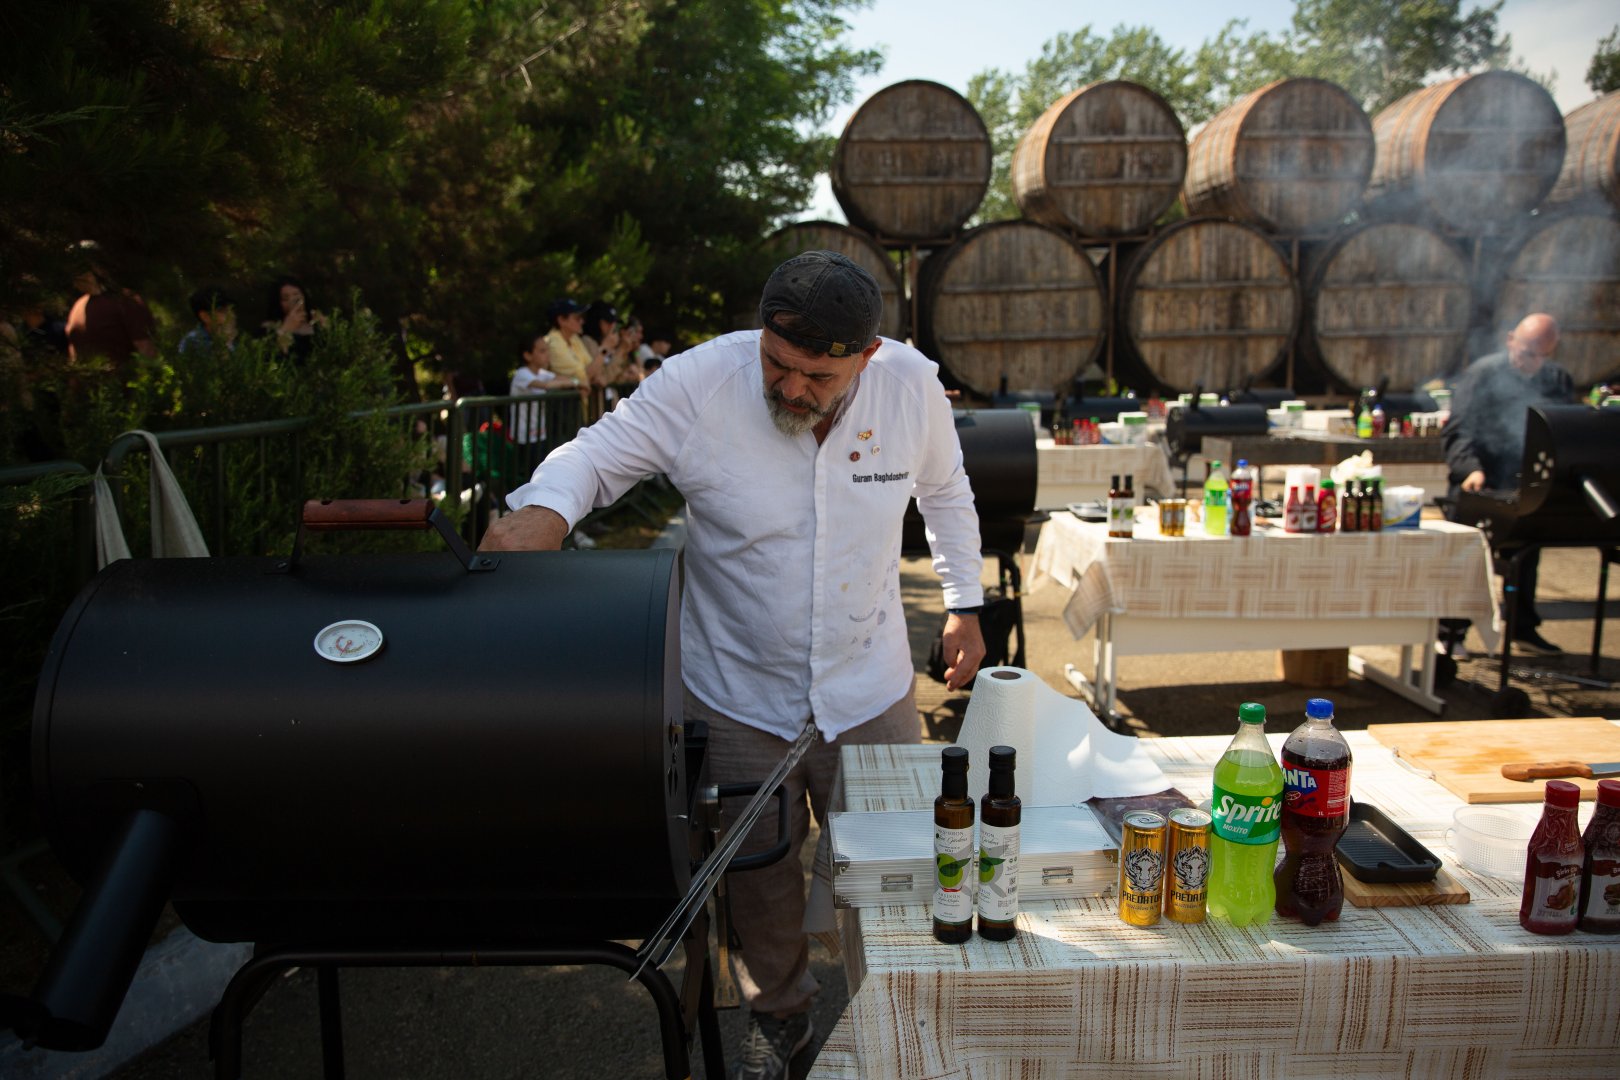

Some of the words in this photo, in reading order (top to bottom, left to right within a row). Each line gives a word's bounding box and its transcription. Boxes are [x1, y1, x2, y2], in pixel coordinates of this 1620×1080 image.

[852, 473, 873, 483] Guram
[1280, 767, 1317, 789] ANTA
[1217, 795, 1282, 823] Sprite
[1122, 890, 1161, 905] PREDATO
[1170, 888, 1208, 905] PREDATO
